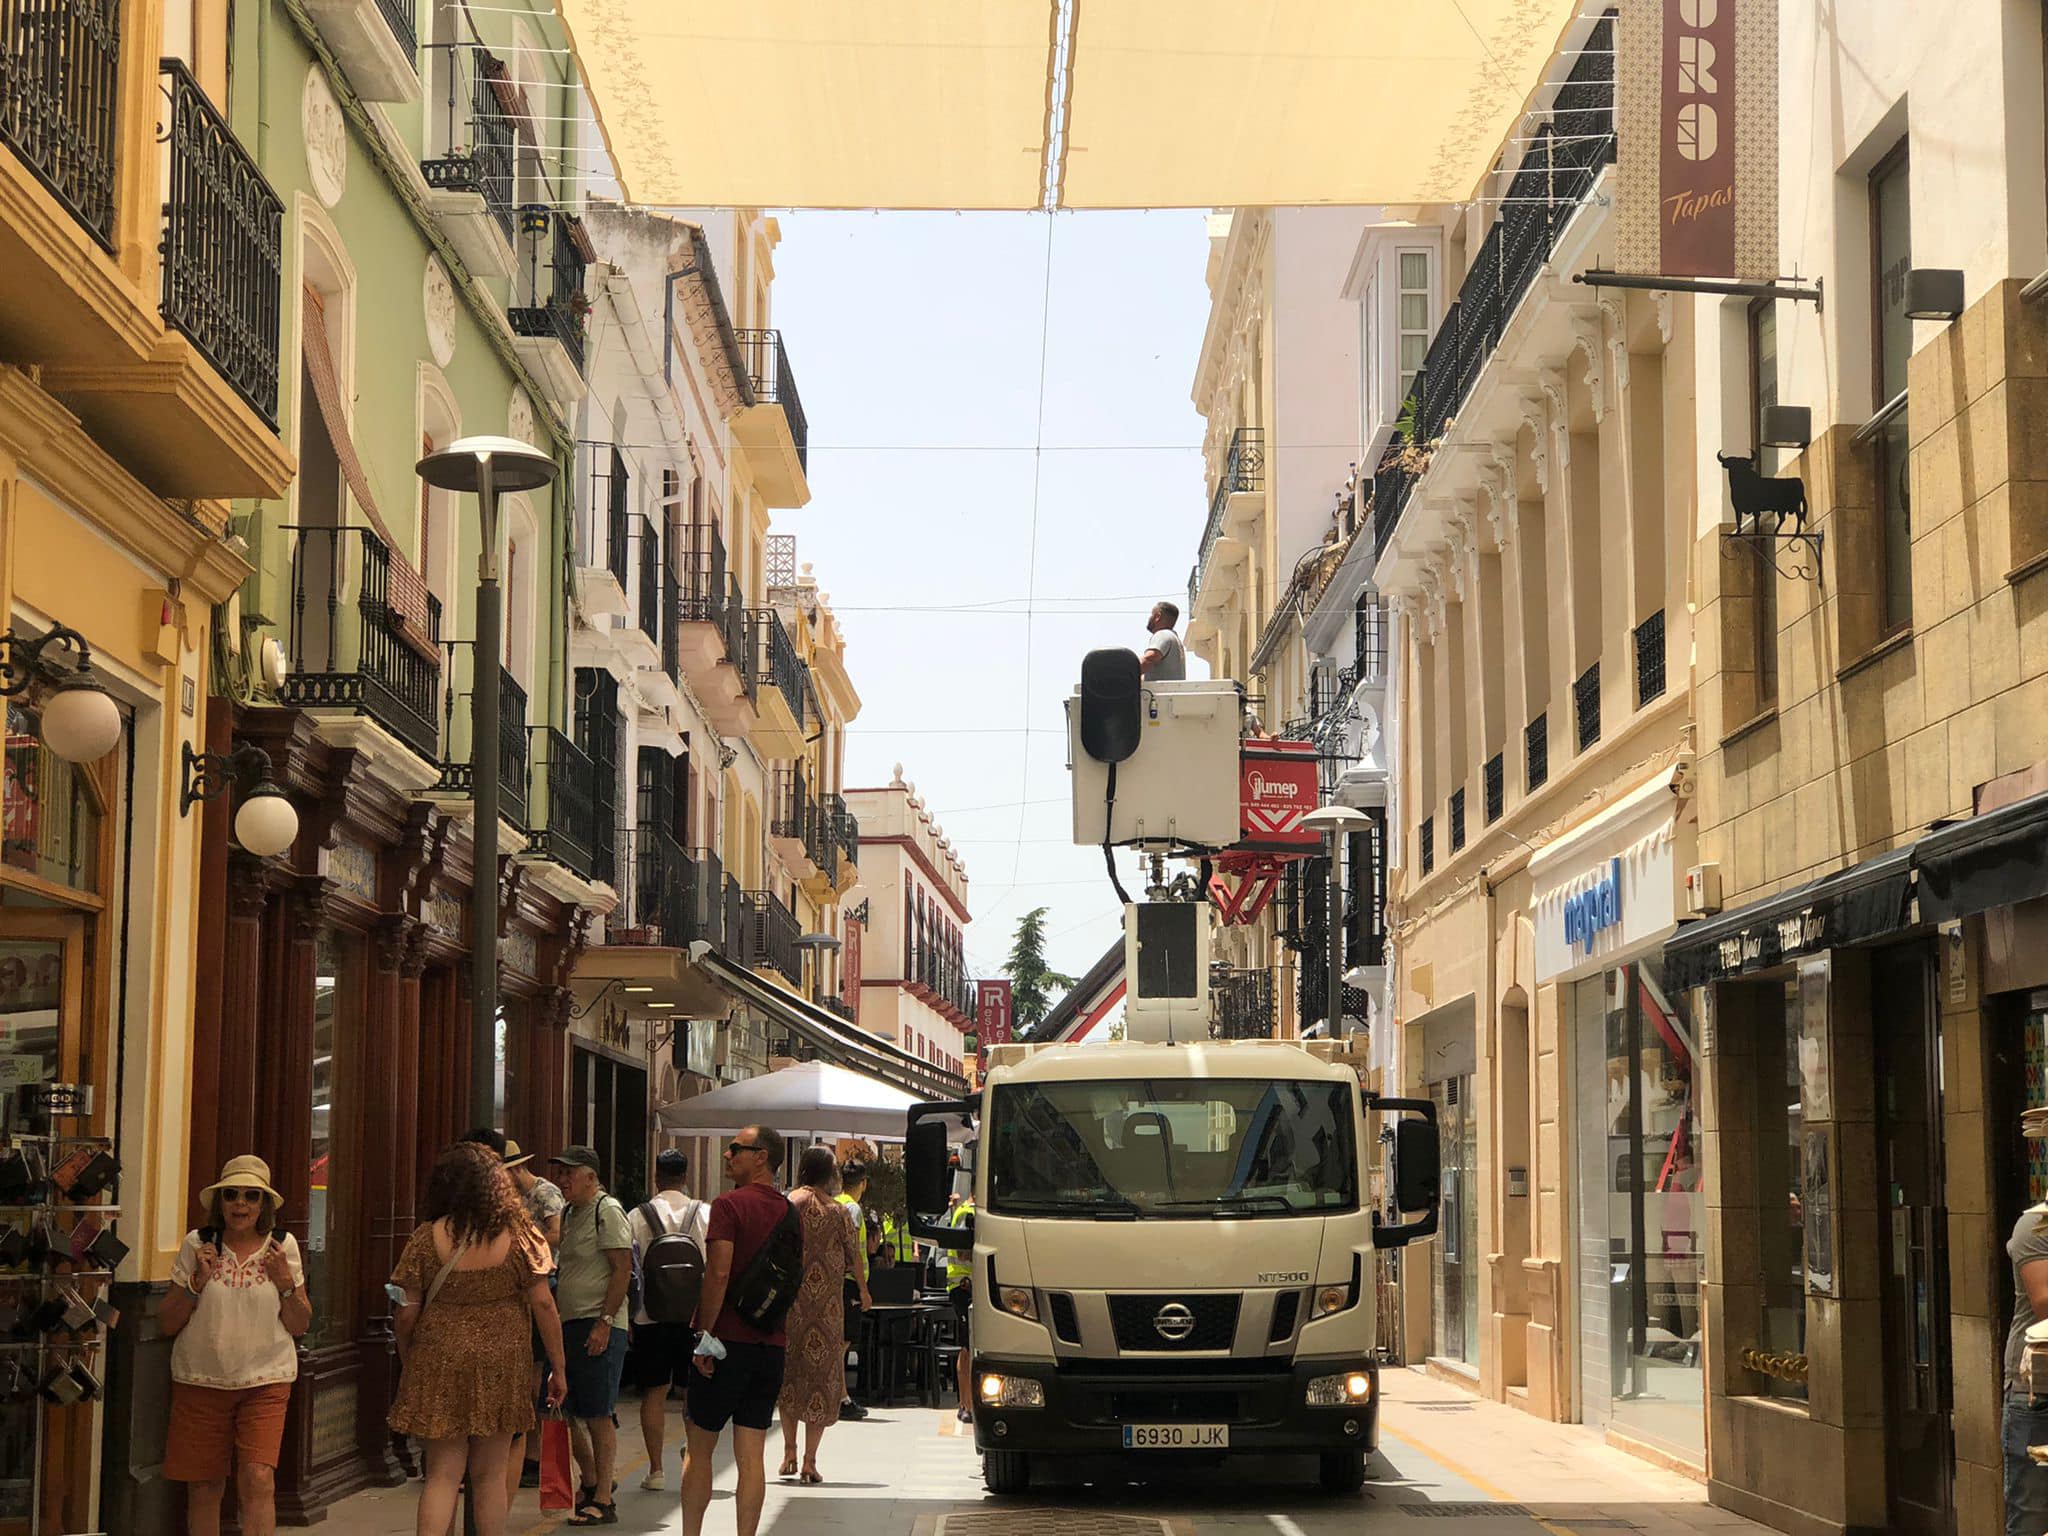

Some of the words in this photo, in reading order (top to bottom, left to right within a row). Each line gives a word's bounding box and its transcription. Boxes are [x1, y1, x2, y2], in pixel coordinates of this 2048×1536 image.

[1664, 185, 1733, 225] Tapas
[1258, 1271, 1310, 1283] NT500
[1136, 1428, 1183, 1445] 6930
[1190, 1428, 1225, 1445] JJK
